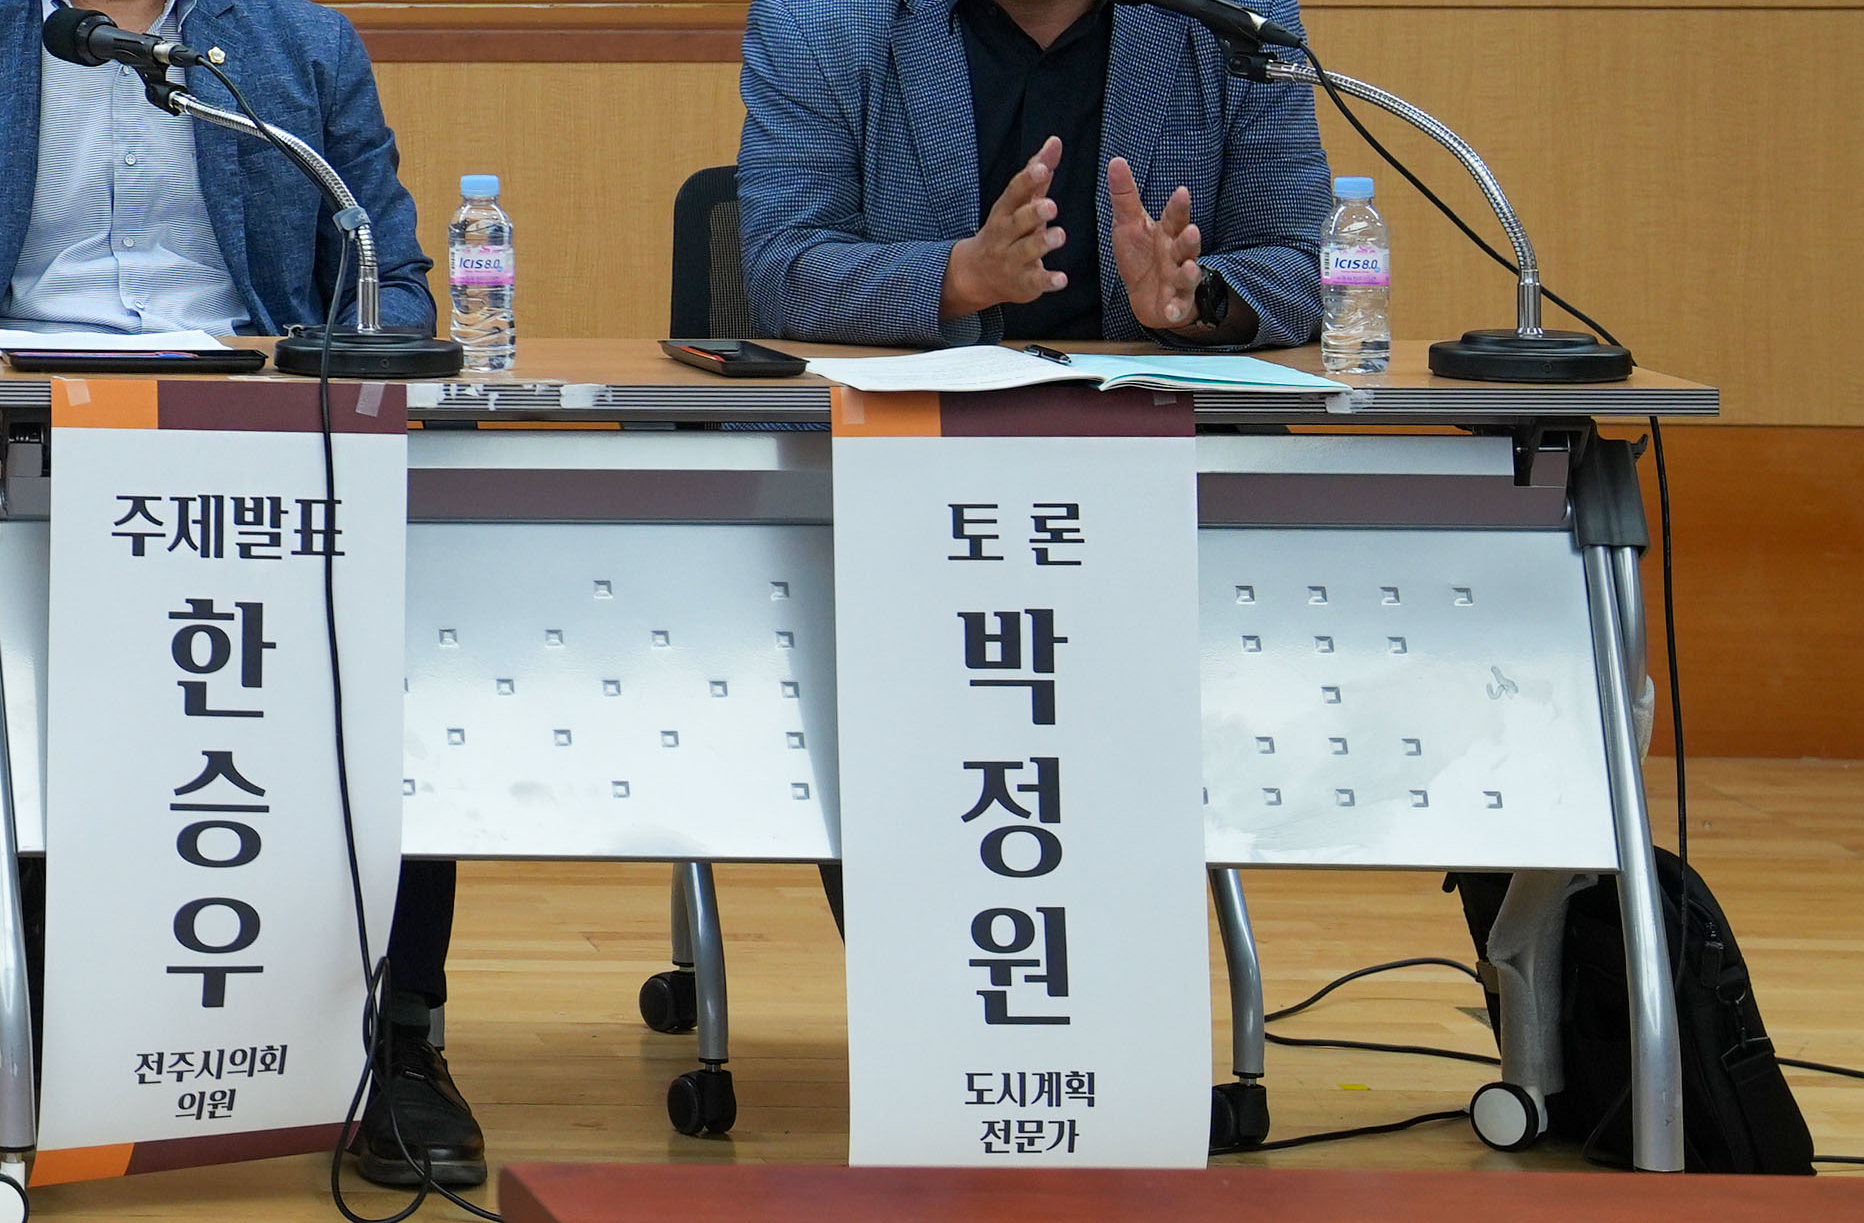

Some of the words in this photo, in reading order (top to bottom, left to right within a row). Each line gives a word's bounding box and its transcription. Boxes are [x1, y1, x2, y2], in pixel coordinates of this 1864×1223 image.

[111, 494, 346, 560] 주제발표
[166, 598, 277, 1008] 한승우
[957, 608, 1071, 1025] 박정원
[134, 1044, 288, 1085] 전주시의회
[175, 1088, 237, 1121] 의원
[964, 1070, 1095, 1108] 도시계획
[980, 1119, 1080, 1154] 전문가
